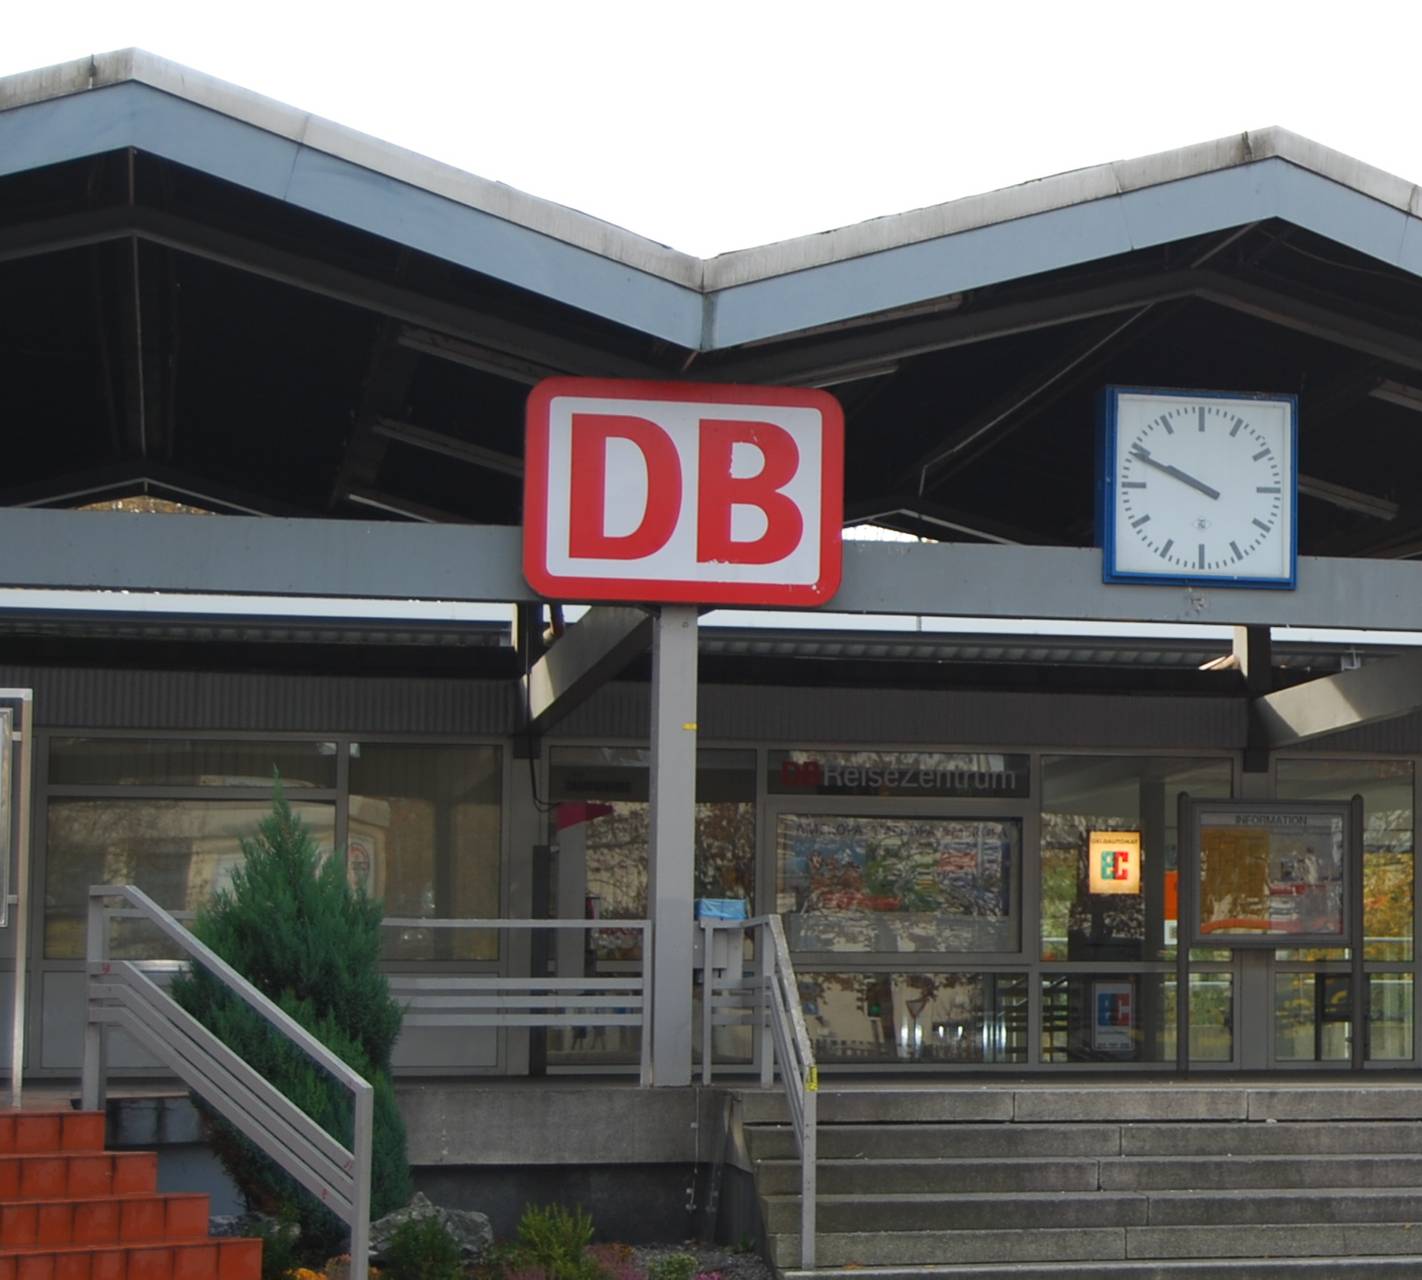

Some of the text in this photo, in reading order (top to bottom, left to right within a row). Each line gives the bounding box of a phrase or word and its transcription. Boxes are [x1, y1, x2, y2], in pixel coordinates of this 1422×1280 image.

[569, 413, 804, 566] DB
[782, 761, 1016, 789] DB ReiseZentrum
[1235, 815, 1308, 825] INFORMATION
